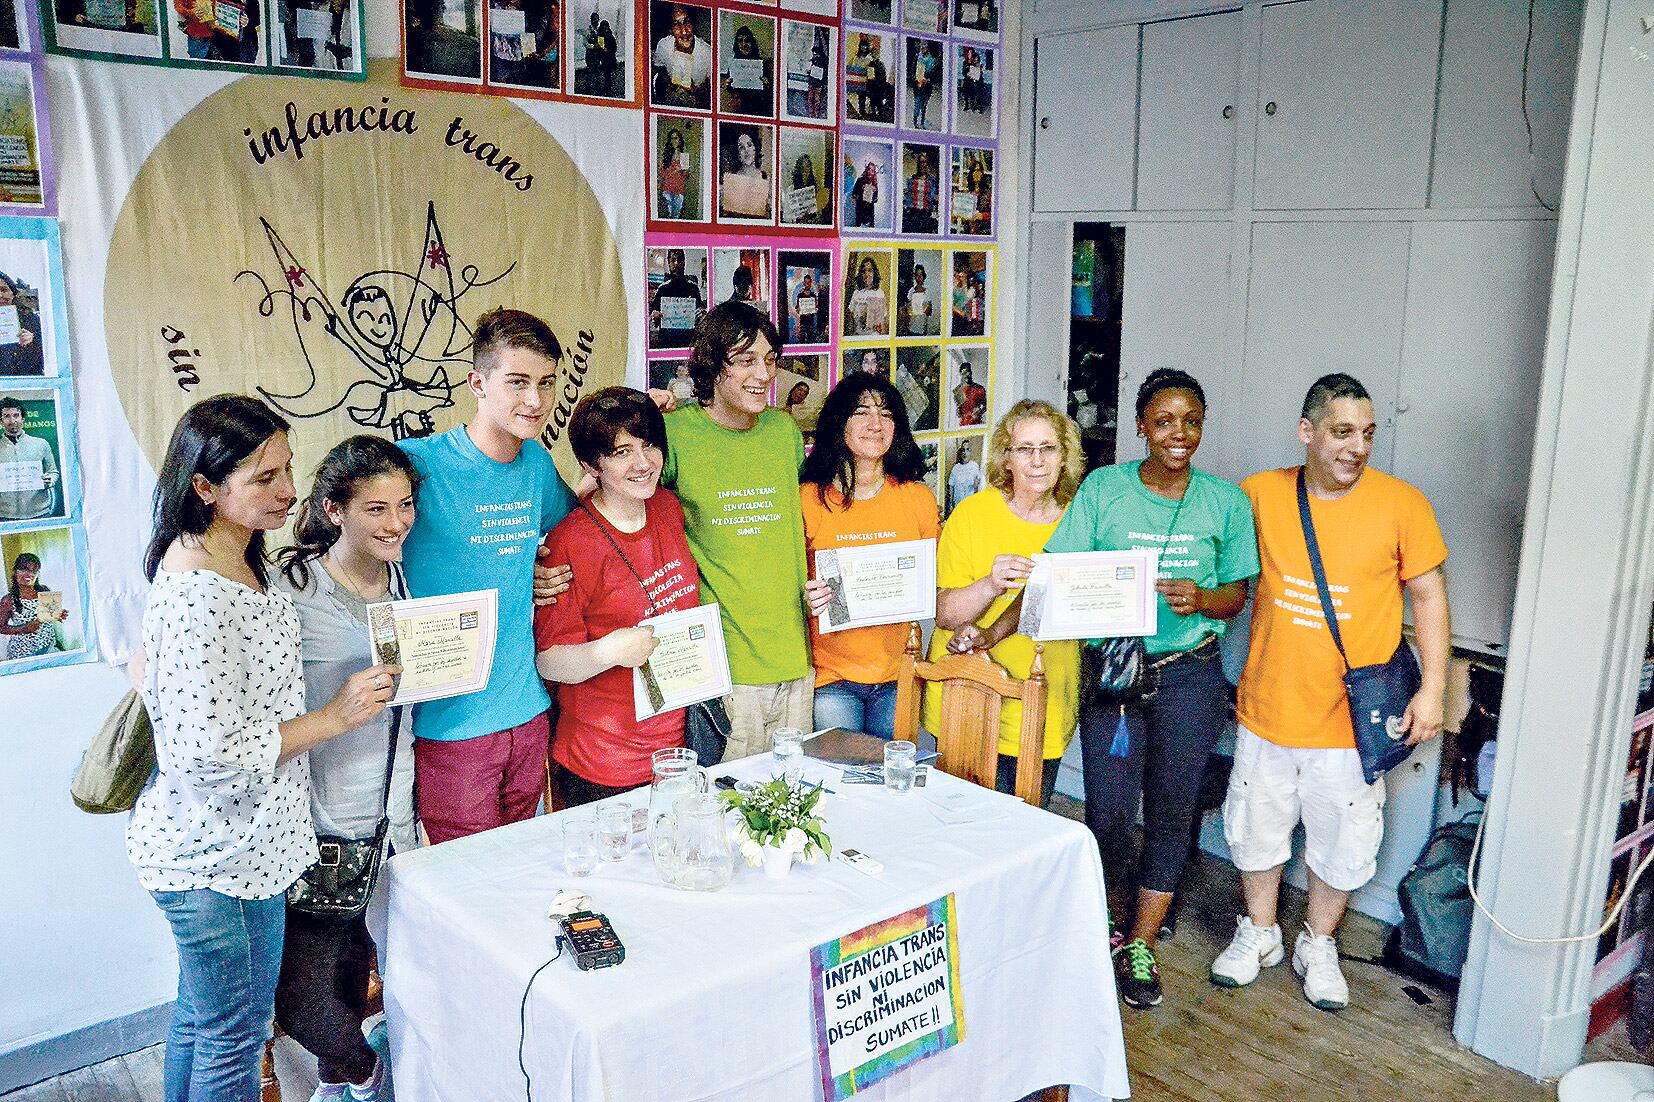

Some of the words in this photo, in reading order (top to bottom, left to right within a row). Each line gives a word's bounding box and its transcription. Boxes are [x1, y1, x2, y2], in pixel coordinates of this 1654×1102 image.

[243, 97, 418, 165] infancia
[444, 107, 534, 191] trans
[160, 314, 201, 392] sin
[717, 489, 755, 499] INFANCIAS
[755, 486, 776, 495] TRANS
[723, 504, 737, 512] SIN
[737, 500, 773, 510] VIOLENCIA
[481, 519, 497, 528] SIN
[873, 531, 897, 539] TRANS
[497, 545, 521, 556] SUMATE
[825, 945, 899, 990] INFANCIA
[900, 922, 945, 957] TRANS
[836, 985, 862, 1010] SIN
[868, 946, 947, 993] VIOLENCIA
[872, 989, 889, 1008] NI
[828, 975, 945, 1046] DISCRIMINACION
